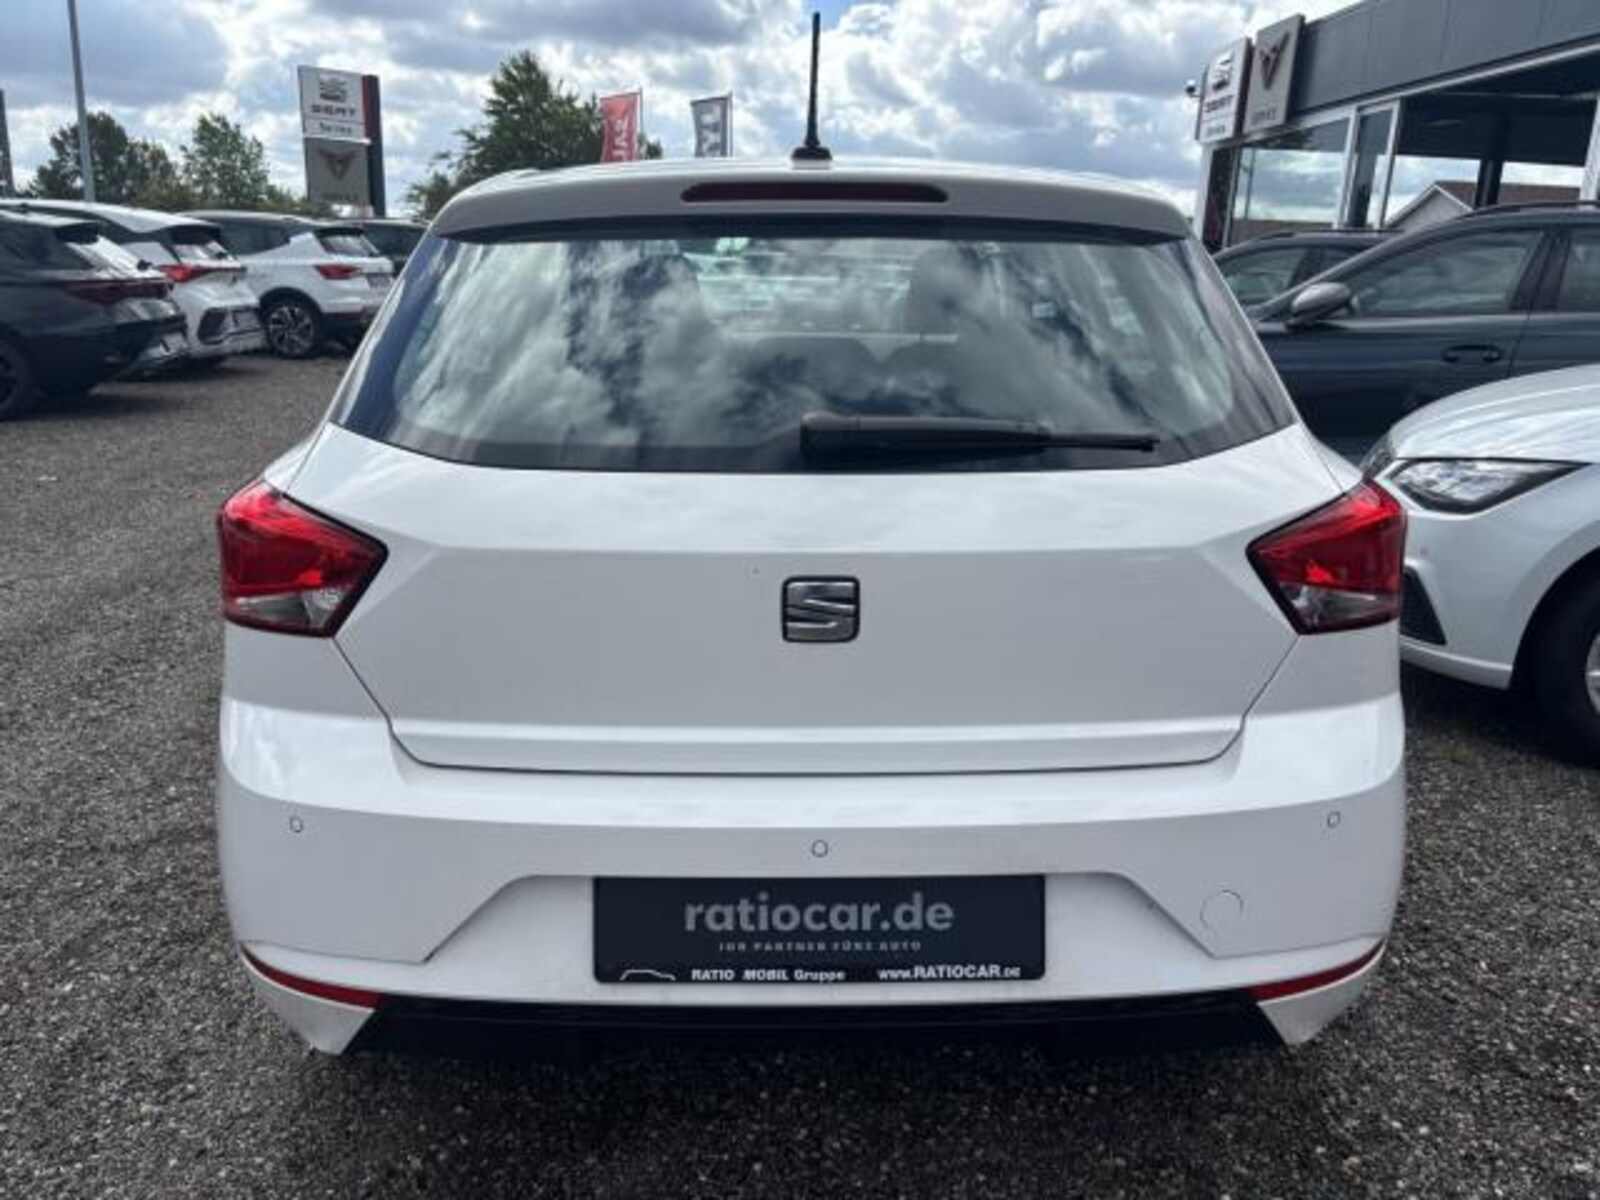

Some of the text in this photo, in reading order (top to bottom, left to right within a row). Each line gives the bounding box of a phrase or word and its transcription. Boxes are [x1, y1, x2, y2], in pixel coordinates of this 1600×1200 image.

[684, 892, 954, 932] ratiocar.de
[691, 968, 846, 985] RATIO MOBIL Gruppe
